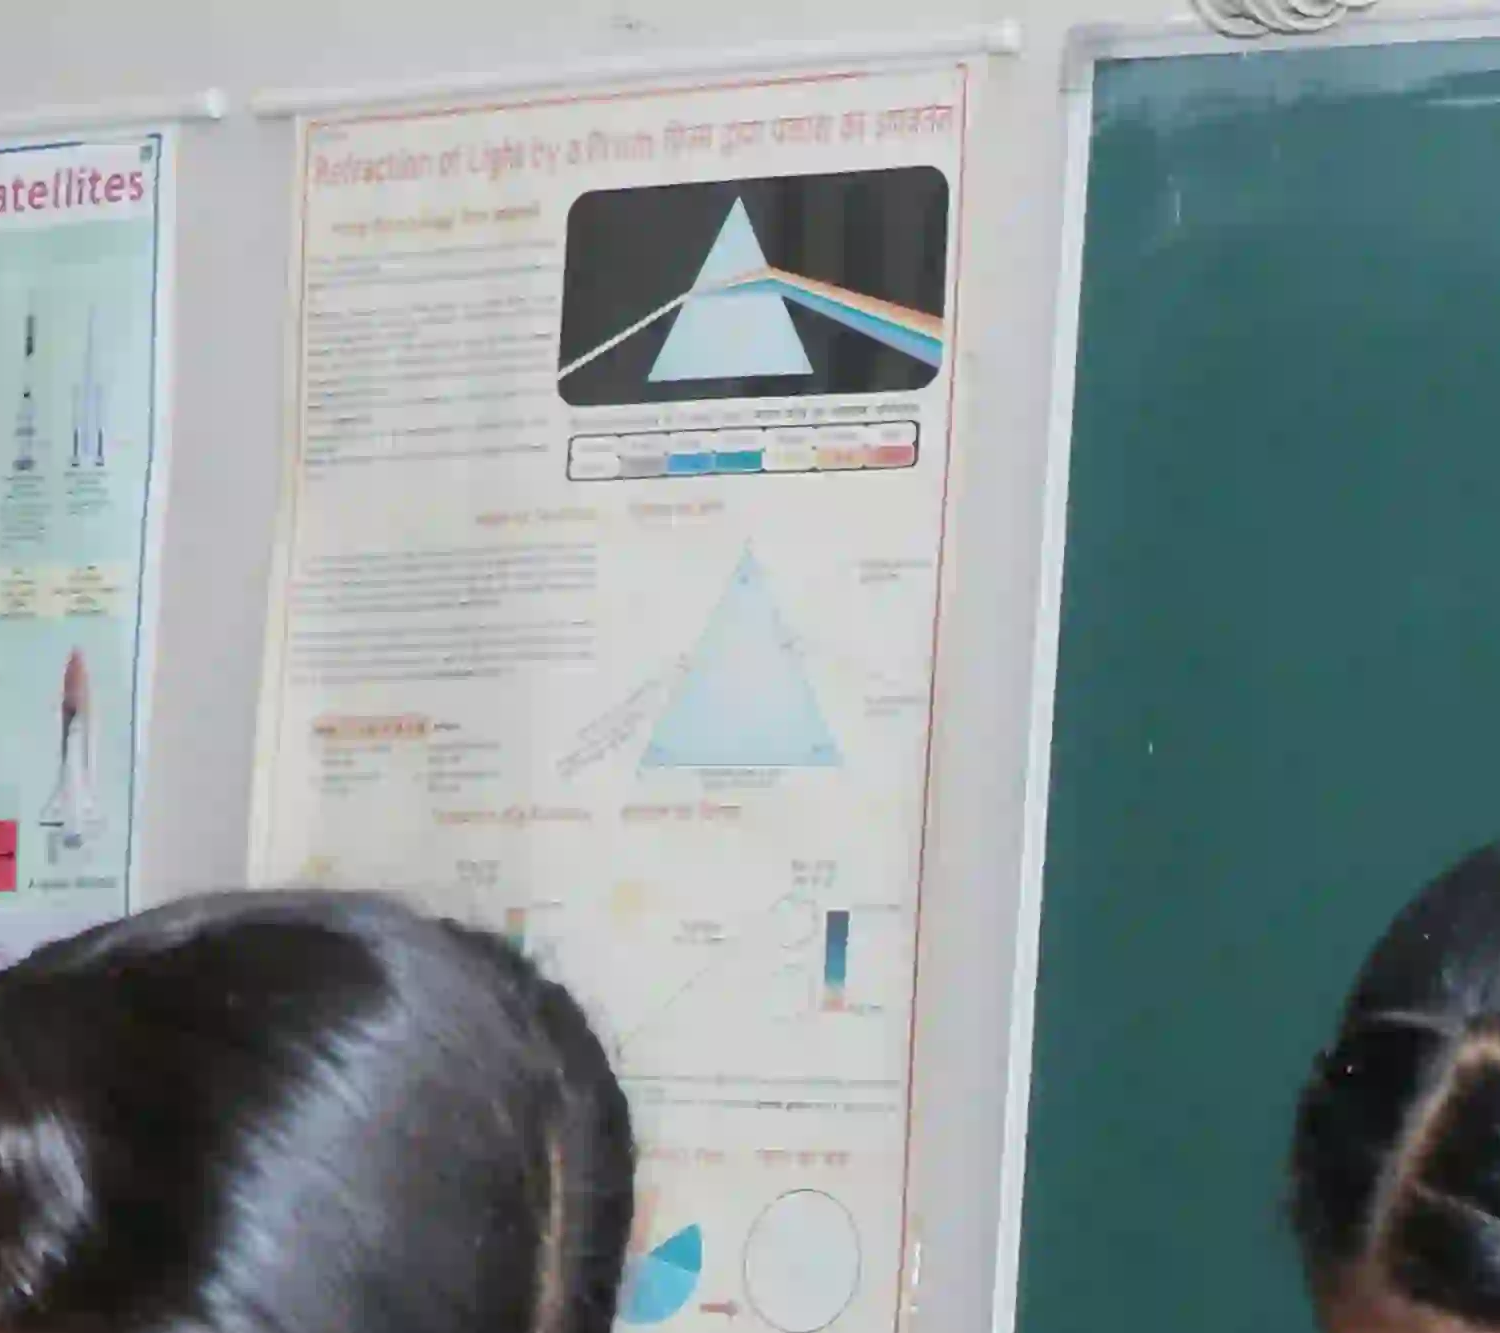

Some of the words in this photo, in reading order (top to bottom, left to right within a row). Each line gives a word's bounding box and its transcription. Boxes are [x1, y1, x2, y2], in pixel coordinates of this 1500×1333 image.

[313, 147, 432, 186] Refraction
[438, 146, 461, 176] of
[468, 138, 524, 181] Light
